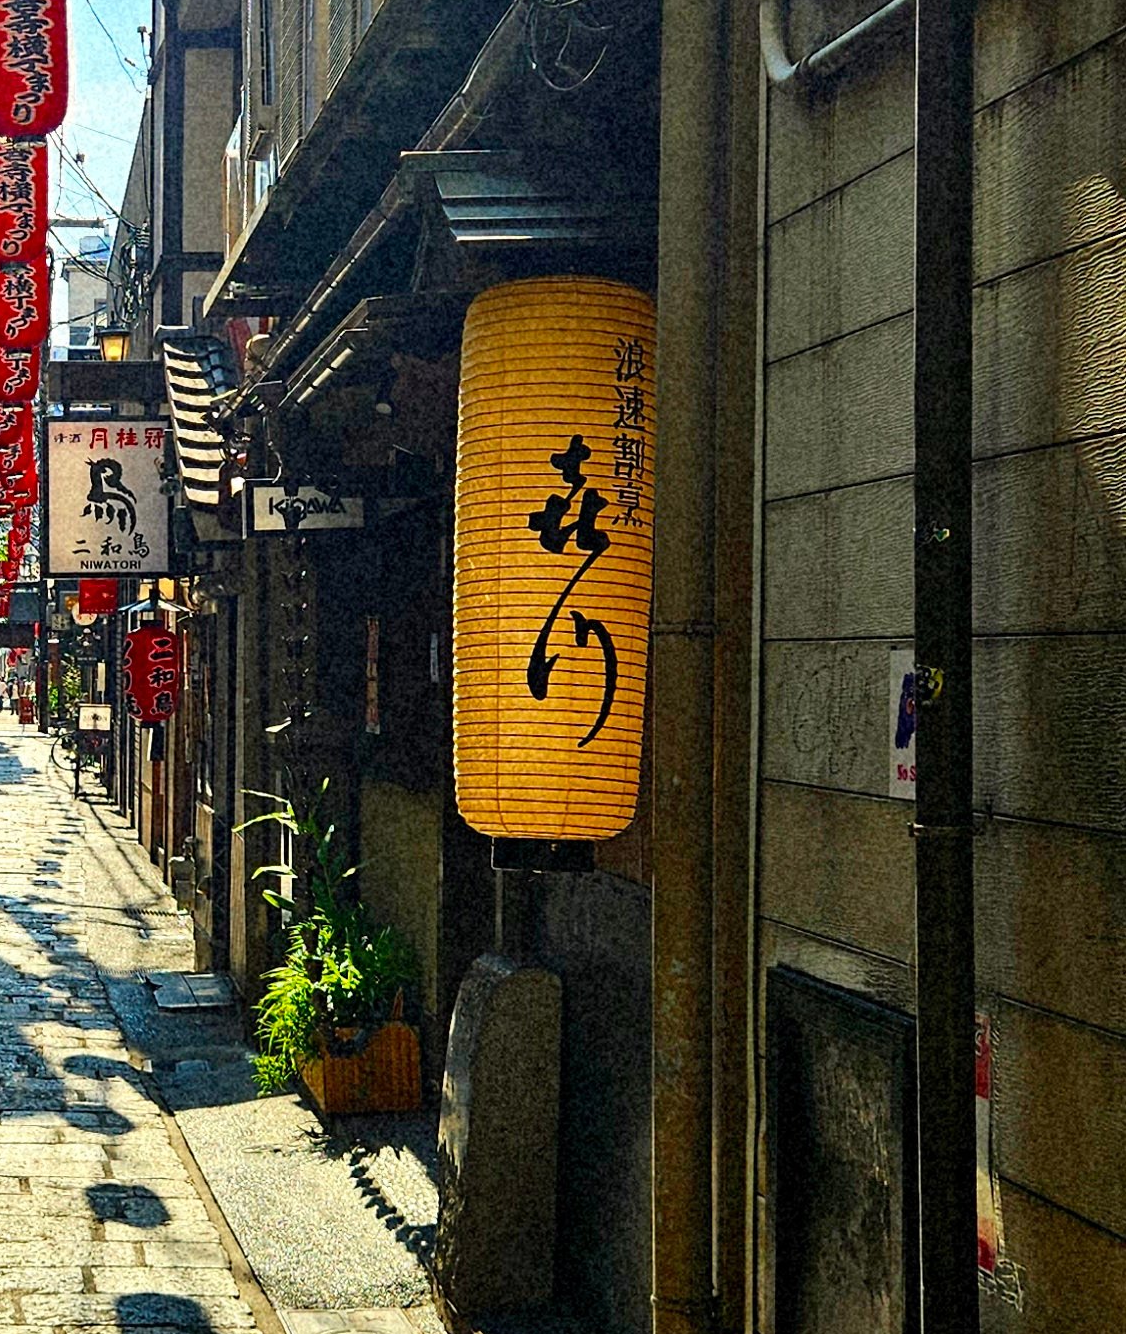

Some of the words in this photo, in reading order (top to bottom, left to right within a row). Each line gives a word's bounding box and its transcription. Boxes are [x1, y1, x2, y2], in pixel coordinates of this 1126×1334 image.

[89, 427, 165, 449] 月桂冠
[611, 336, 649, 530] 浪速割烹
[80, 560, 142, 570] NIWATORI
